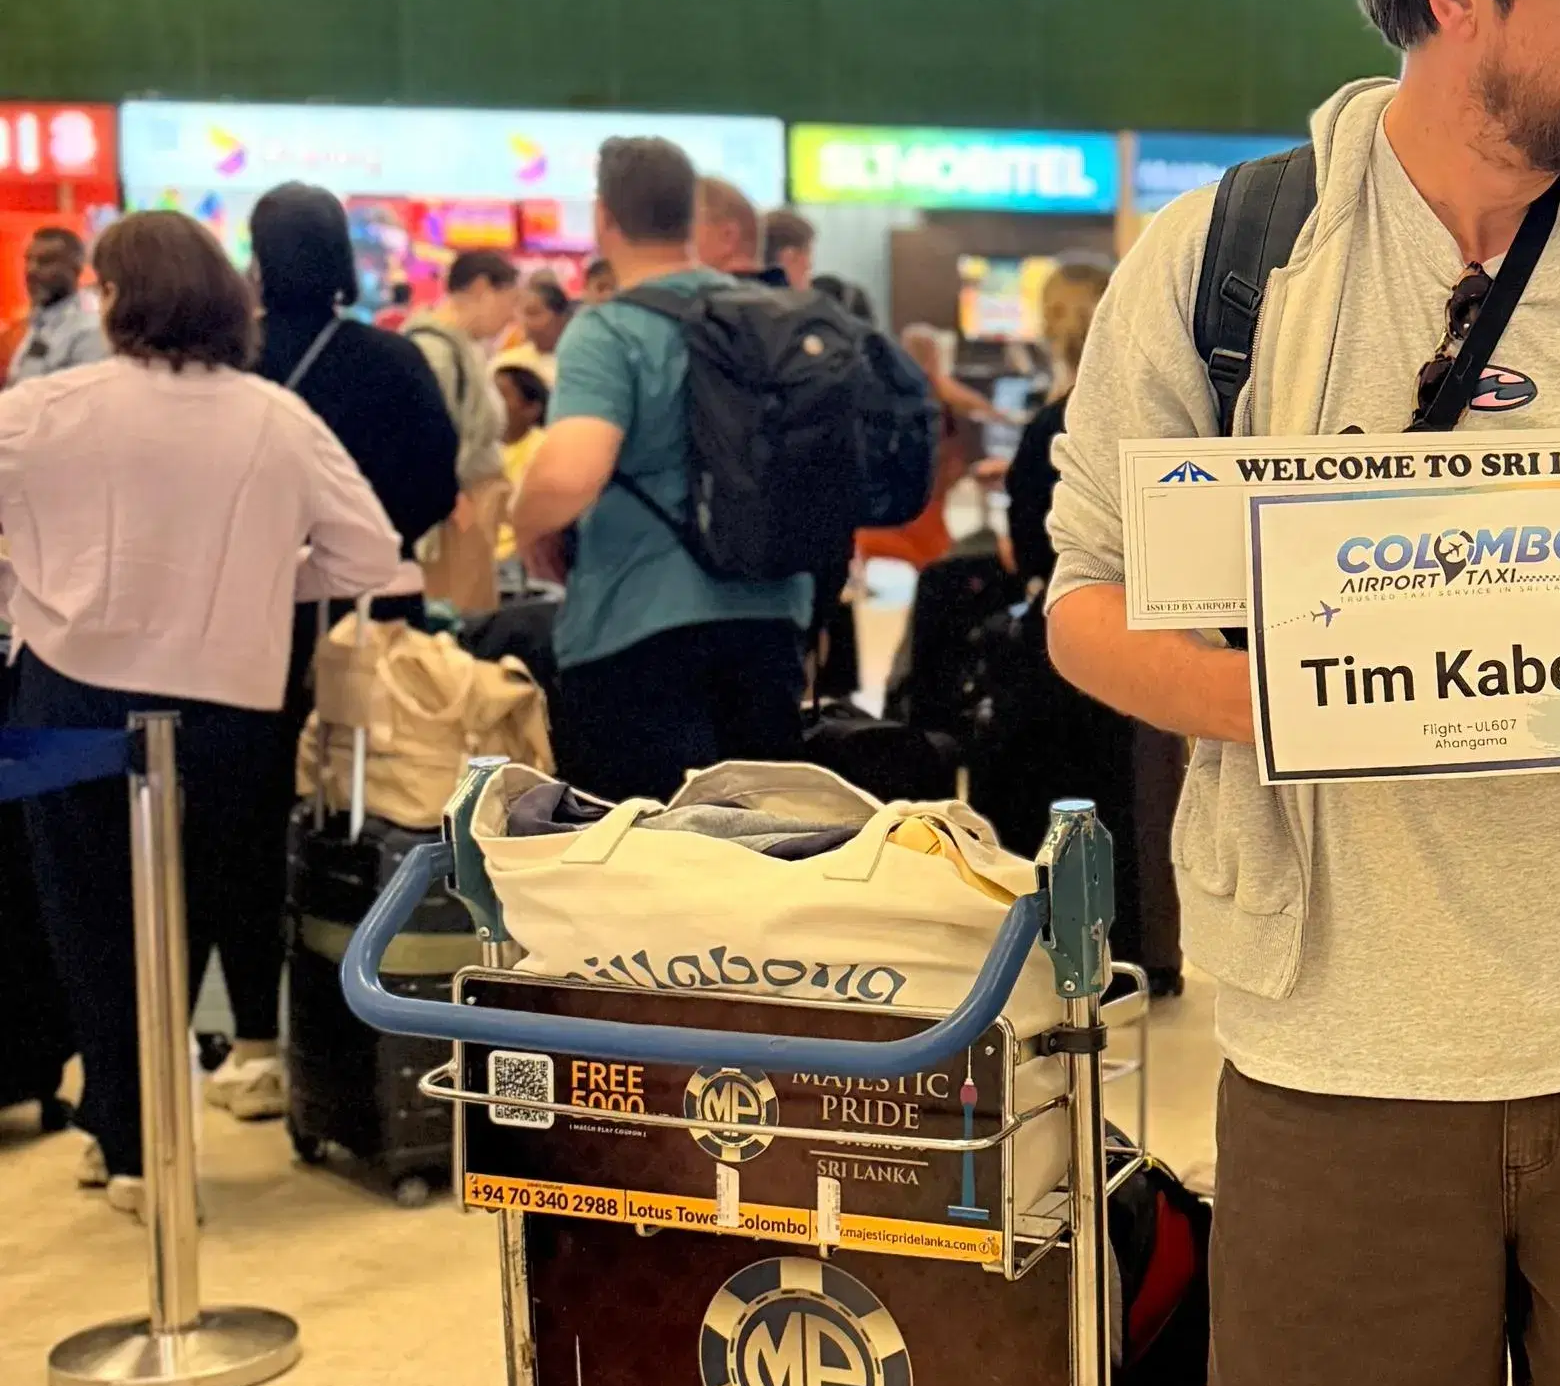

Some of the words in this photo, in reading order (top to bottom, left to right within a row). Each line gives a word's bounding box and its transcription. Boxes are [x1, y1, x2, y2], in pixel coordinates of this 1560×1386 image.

[1236, 455, 1414, 482] WELCOME
[1424, 453, 1472, 478] TO
[1482, 452, 1544, 475] SRI
[1340, 573, 1441, 594] AIRPORT
[1438, 587, 1492, 598] SERVICE
[1147, 603, 1180, 612] ISSUED
[1182, 602, 1193, 611] BY
[1195, 601, 1236, 610] AIRPORT
[1300, 655, 1415, 707] Tim
[1423, 721, 1462, 737] Flight
[1435, 736, 1508, 750] Ahangama
[572, 1060, 645, 1094] FREE
[821, 1094, 920, 1130] PRIDE
[817, 1159, 847, 1178] SRI
[853, 1163, 919, 1186] LANKA
[472, 1184, 504, 1204] +94
[508, 1187, 530, 1206] 70
[535, 1190, 568, 1211] 340
[573, 1195, 618, 1216] 2988
[628, 1200, 672, 1221] Lotus
[676, 1206, 718, 1225] Towe
